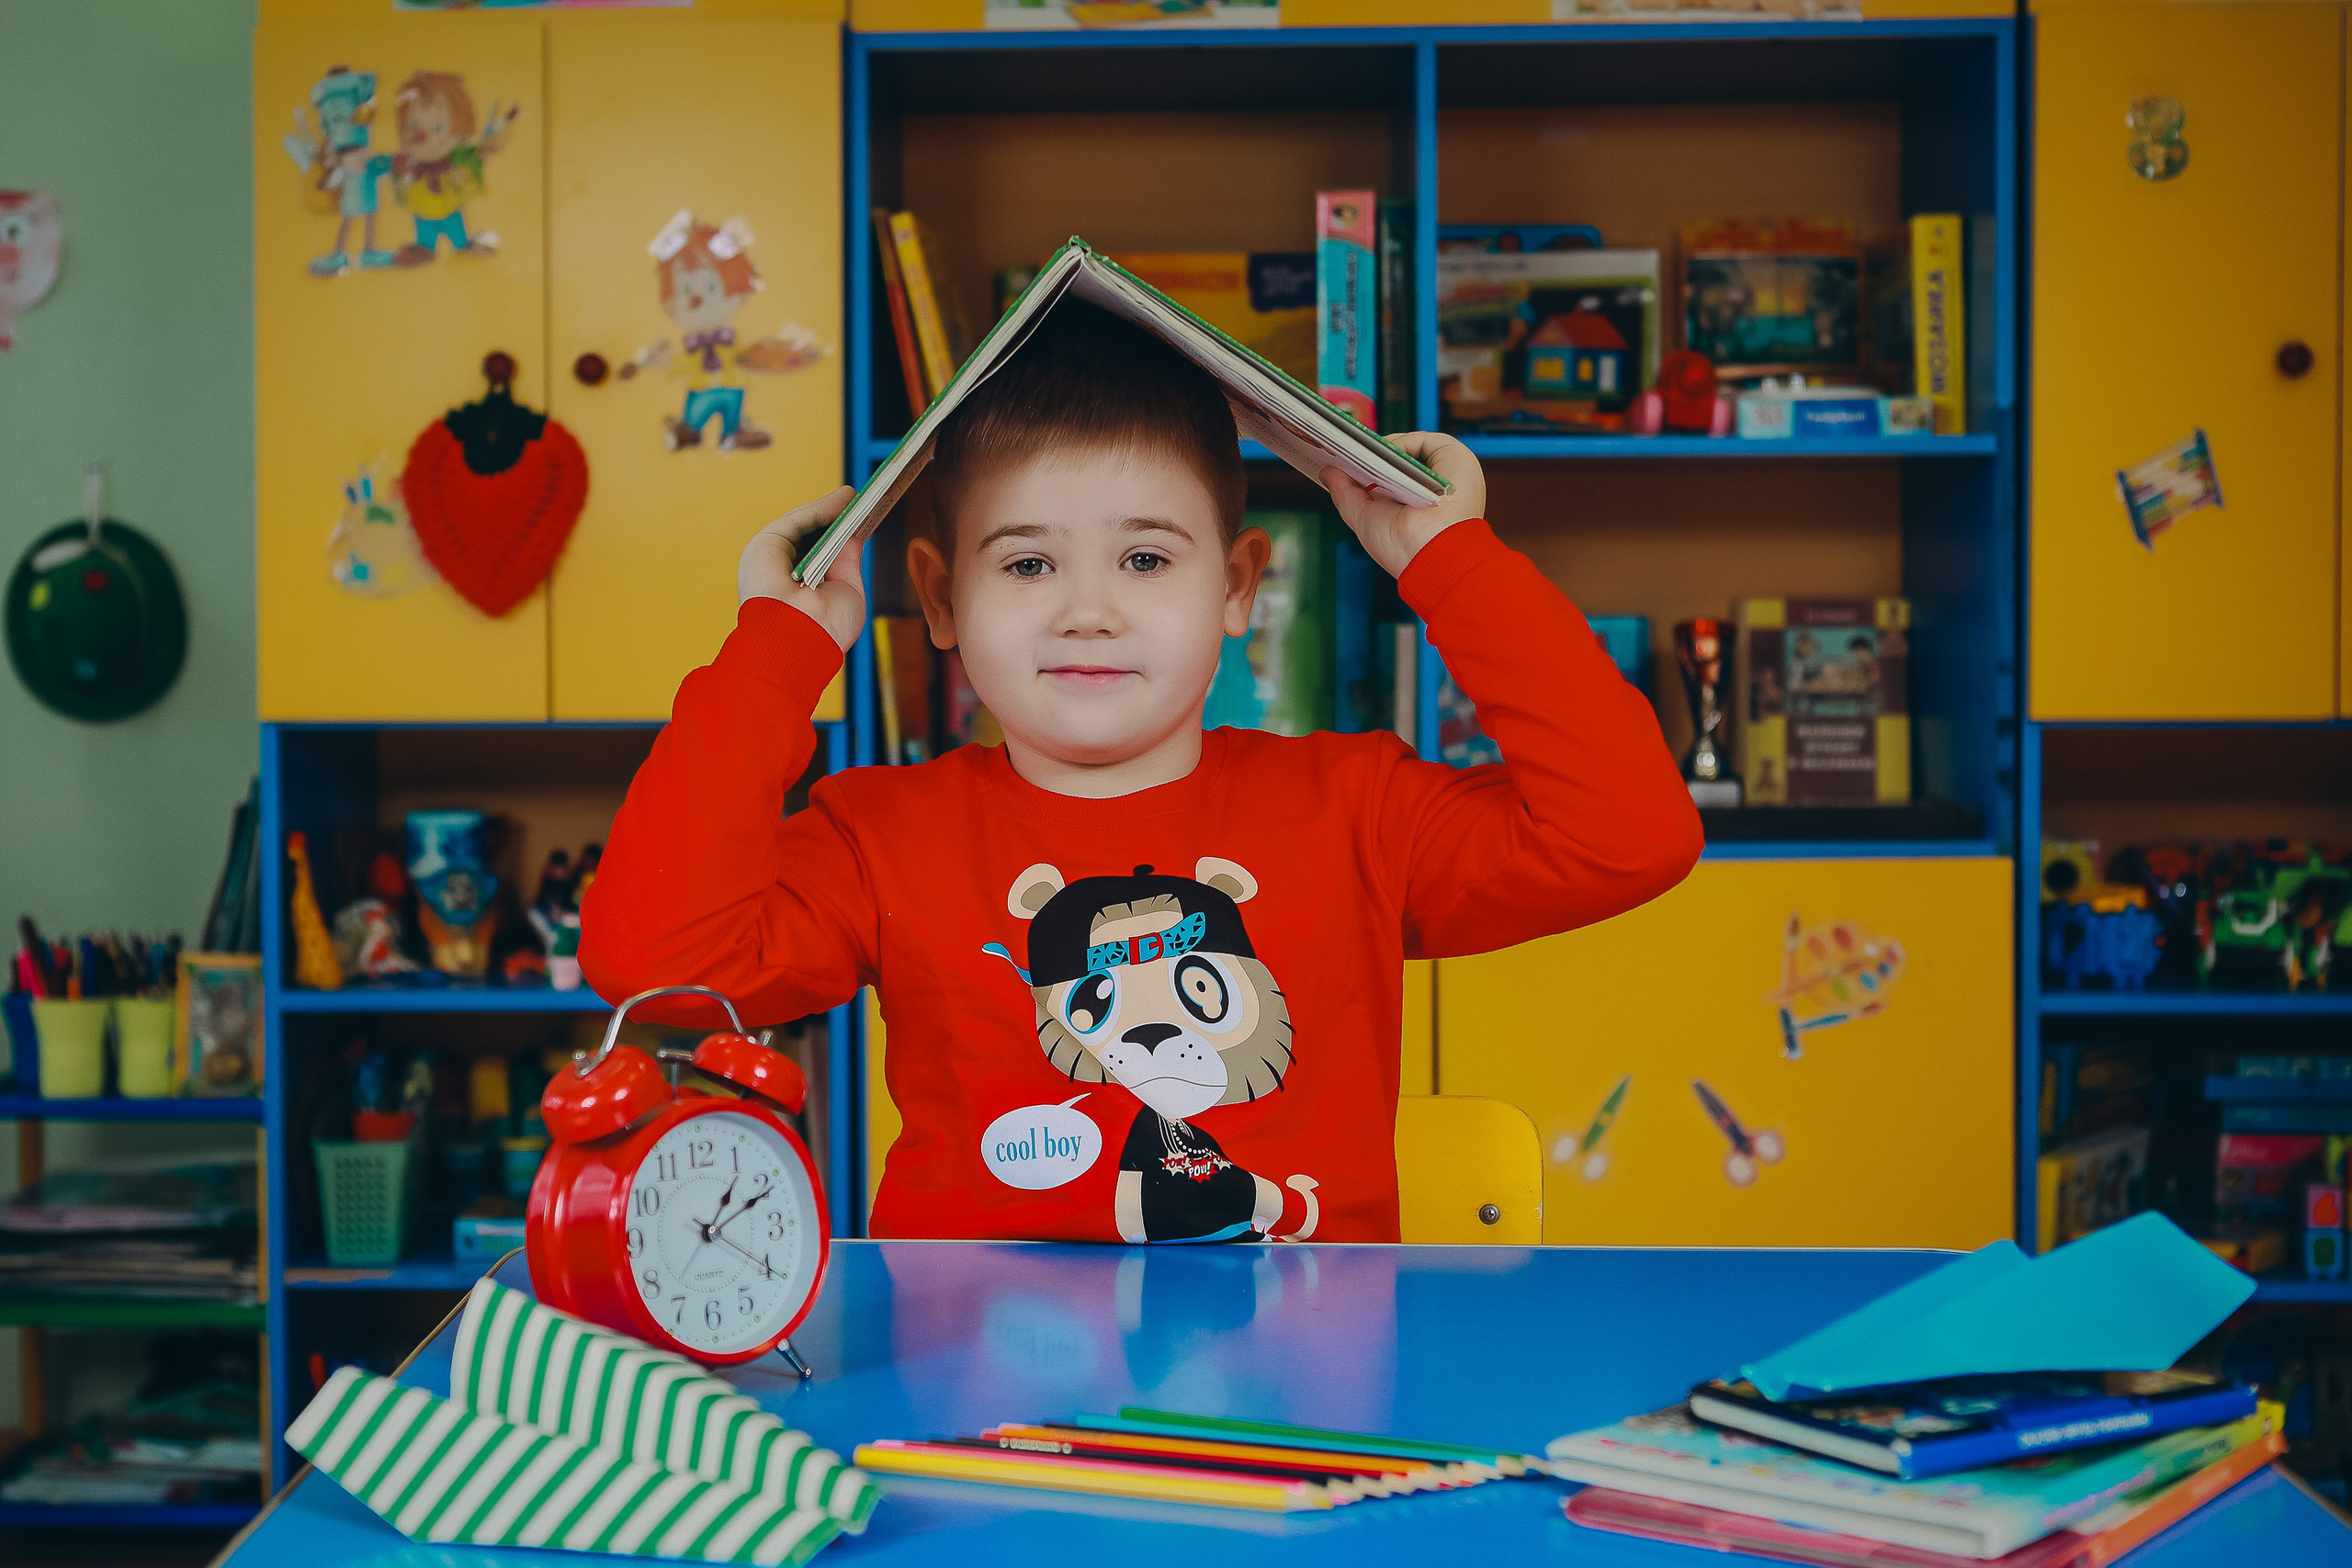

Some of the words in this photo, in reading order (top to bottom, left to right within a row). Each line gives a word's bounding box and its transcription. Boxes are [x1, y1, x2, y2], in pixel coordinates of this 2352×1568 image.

[688, 1140, 714, 1169] 12
[995, 1126, 1037, 1161] cool
[1044, 1123, 1082, 1162] boy
[656, 1153, 679, 1182] 11
[729, 1145, 741, 1174] 1
[1188, 1161, 1211, 1177] POW!
[753, 1173, 769, 1200] 2
[632, 1186, 660, 1218] 10
[766, 1211, 784, 1241] 3
[627, 1227, 643, 1258] 9
[758, 1253, 774, 1281] 4
[642, 1269, 661, 1300] 8
[670, 1294, 686, 1325] 7
[703, 1300, 722, 1331] 6
[737, 1287, 753, 1315] 5
